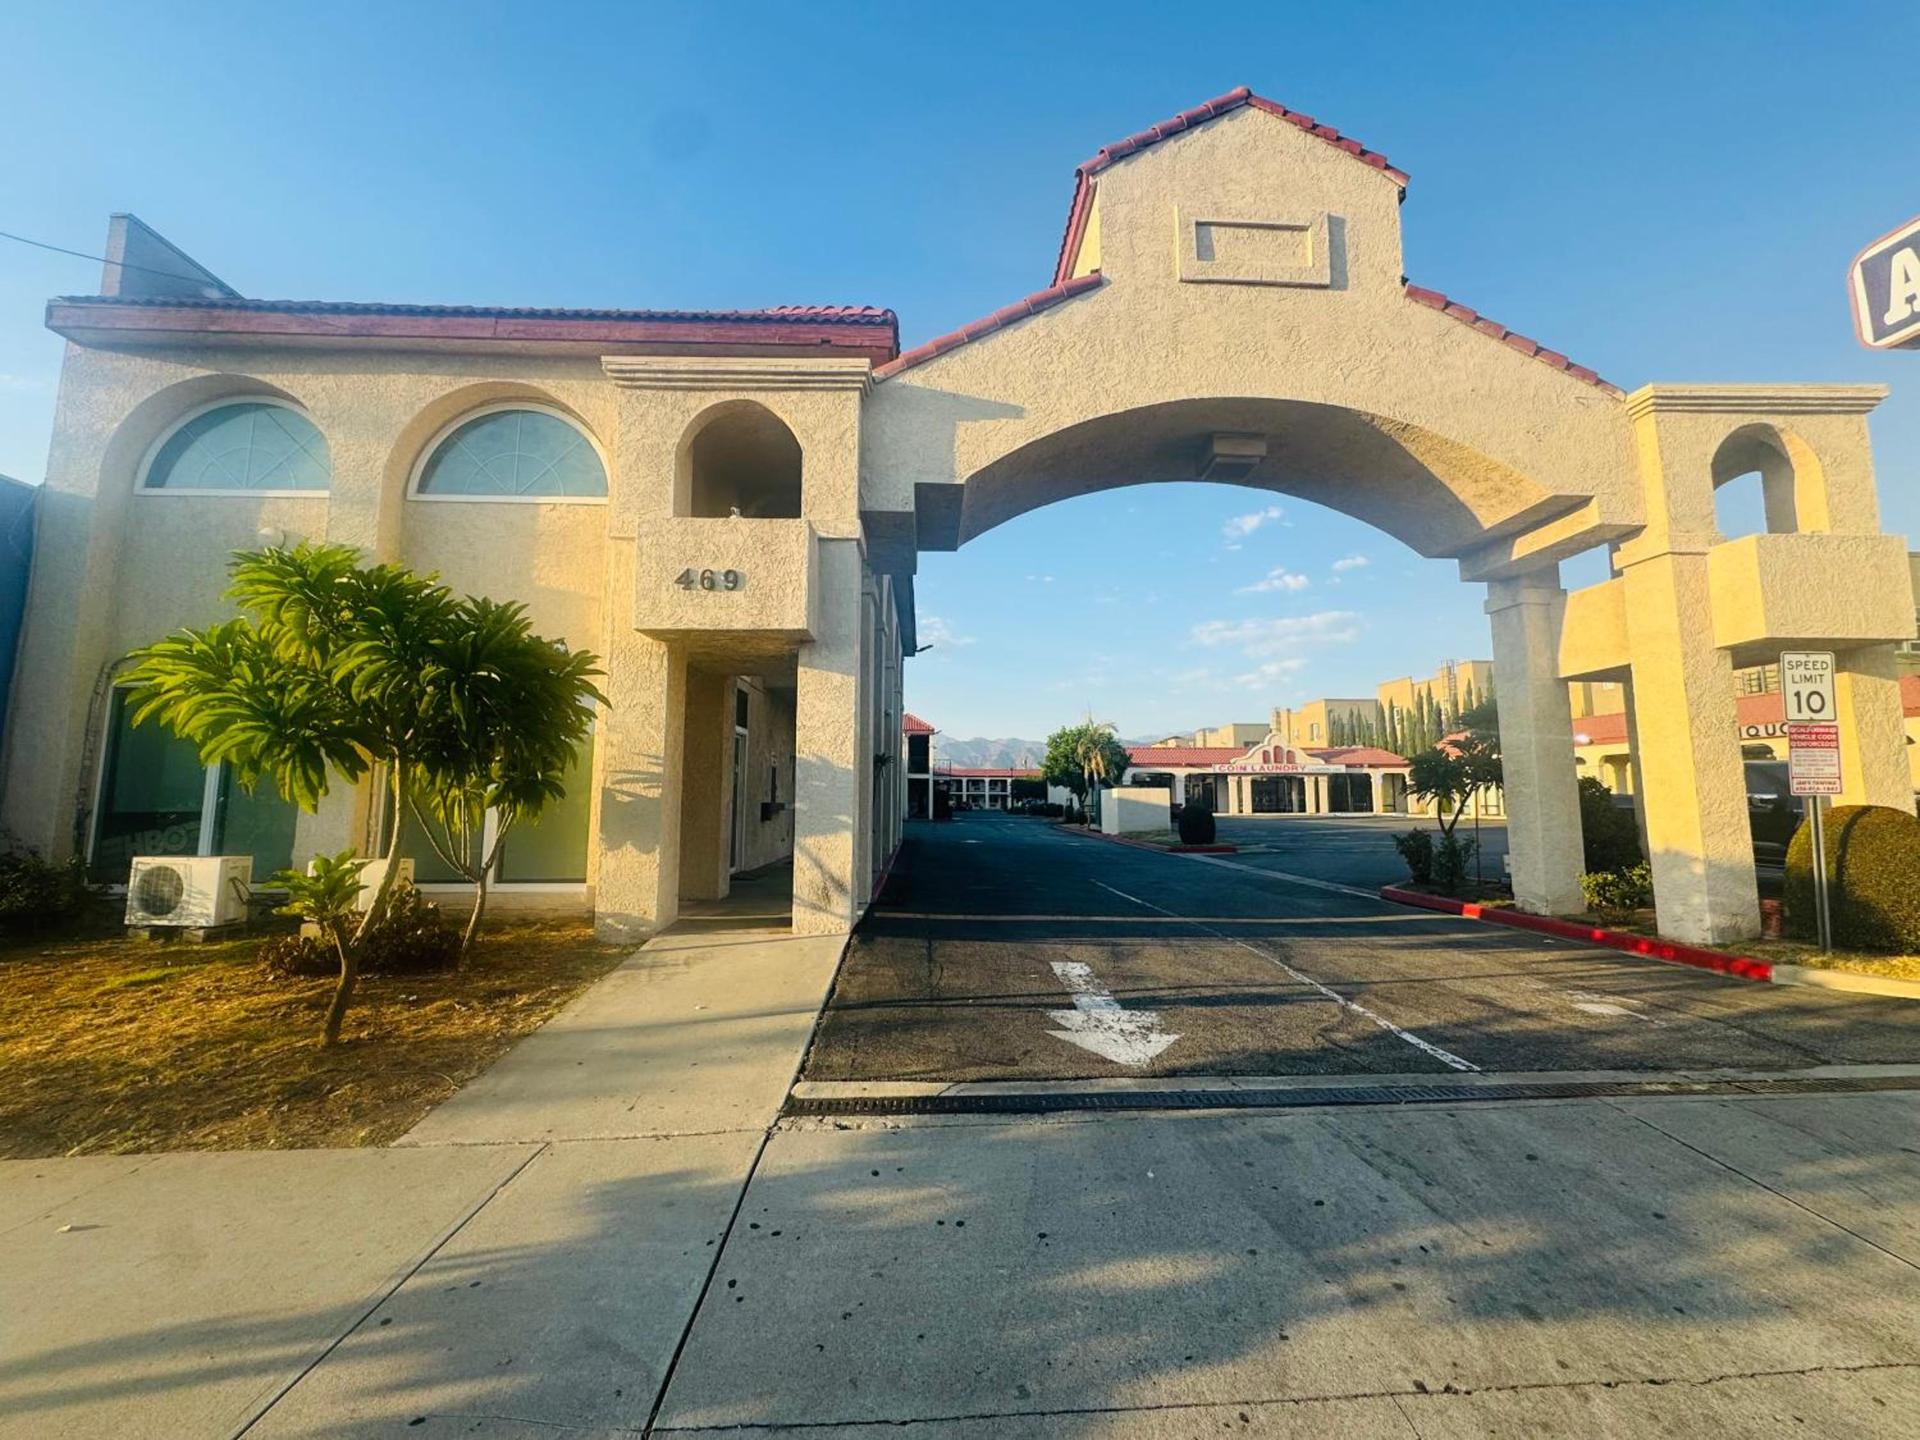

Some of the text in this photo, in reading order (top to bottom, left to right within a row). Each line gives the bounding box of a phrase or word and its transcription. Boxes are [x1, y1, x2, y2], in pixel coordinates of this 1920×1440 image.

[674, 568, 739, 591] 469
[1786, 660, 1829, 671] SPEED
[1791, 673, 1825, 685] LIMIT
[1794, 690, 1825, 714] 10
[1218, 764, 1247, 772] COIN
[1251, 764, 1306, 772] LAUNDRY
